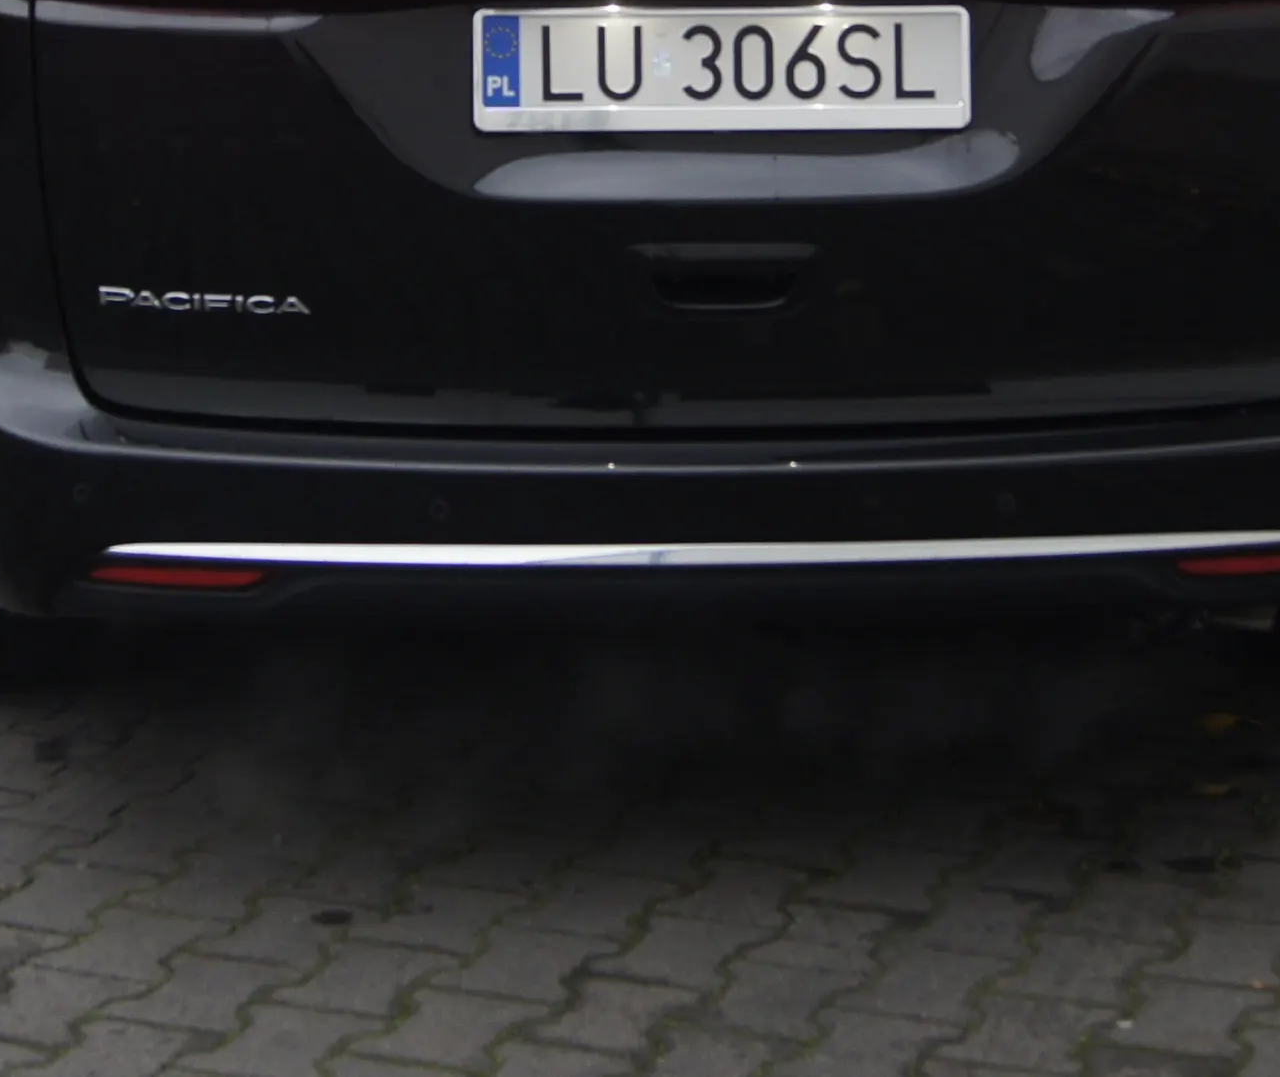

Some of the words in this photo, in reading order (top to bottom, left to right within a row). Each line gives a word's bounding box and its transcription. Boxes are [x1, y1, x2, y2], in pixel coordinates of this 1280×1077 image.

[541, 25, 643, 101] LU
[682, 23, 936, 101] 306SL
[486, 76, 516, 97] PL
[98, 285, 311, 315] PACIFICA
